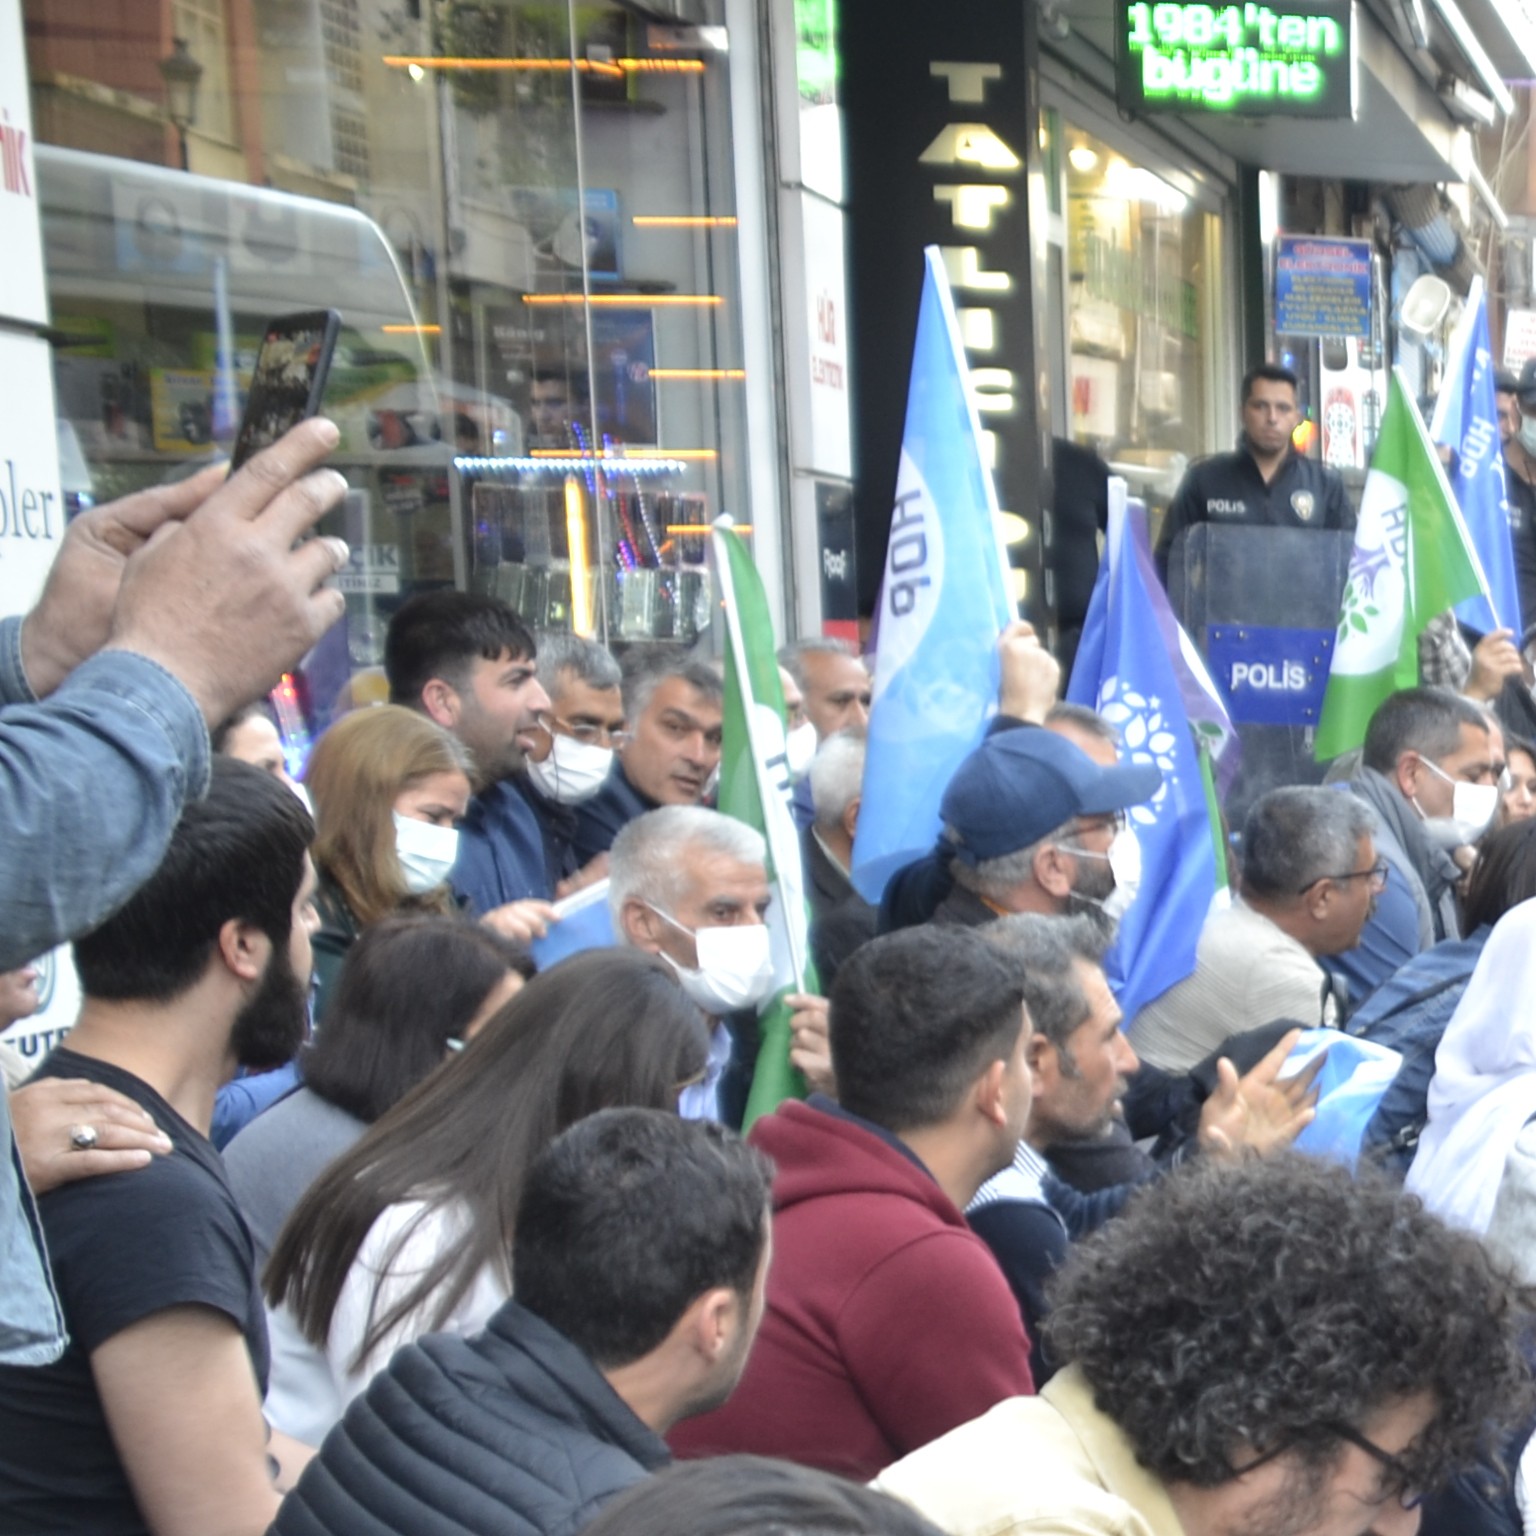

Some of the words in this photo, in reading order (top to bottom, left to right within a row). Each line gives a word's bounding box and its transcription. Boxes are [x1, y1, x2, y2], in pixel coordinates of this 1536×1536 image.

[1127, 2, 1342, 56] 1984'ten
[889, 488, 932, 618] HDP
[1380, 502, 1408, 578] HD
[1230, 659, 1306, 691] POLİS
